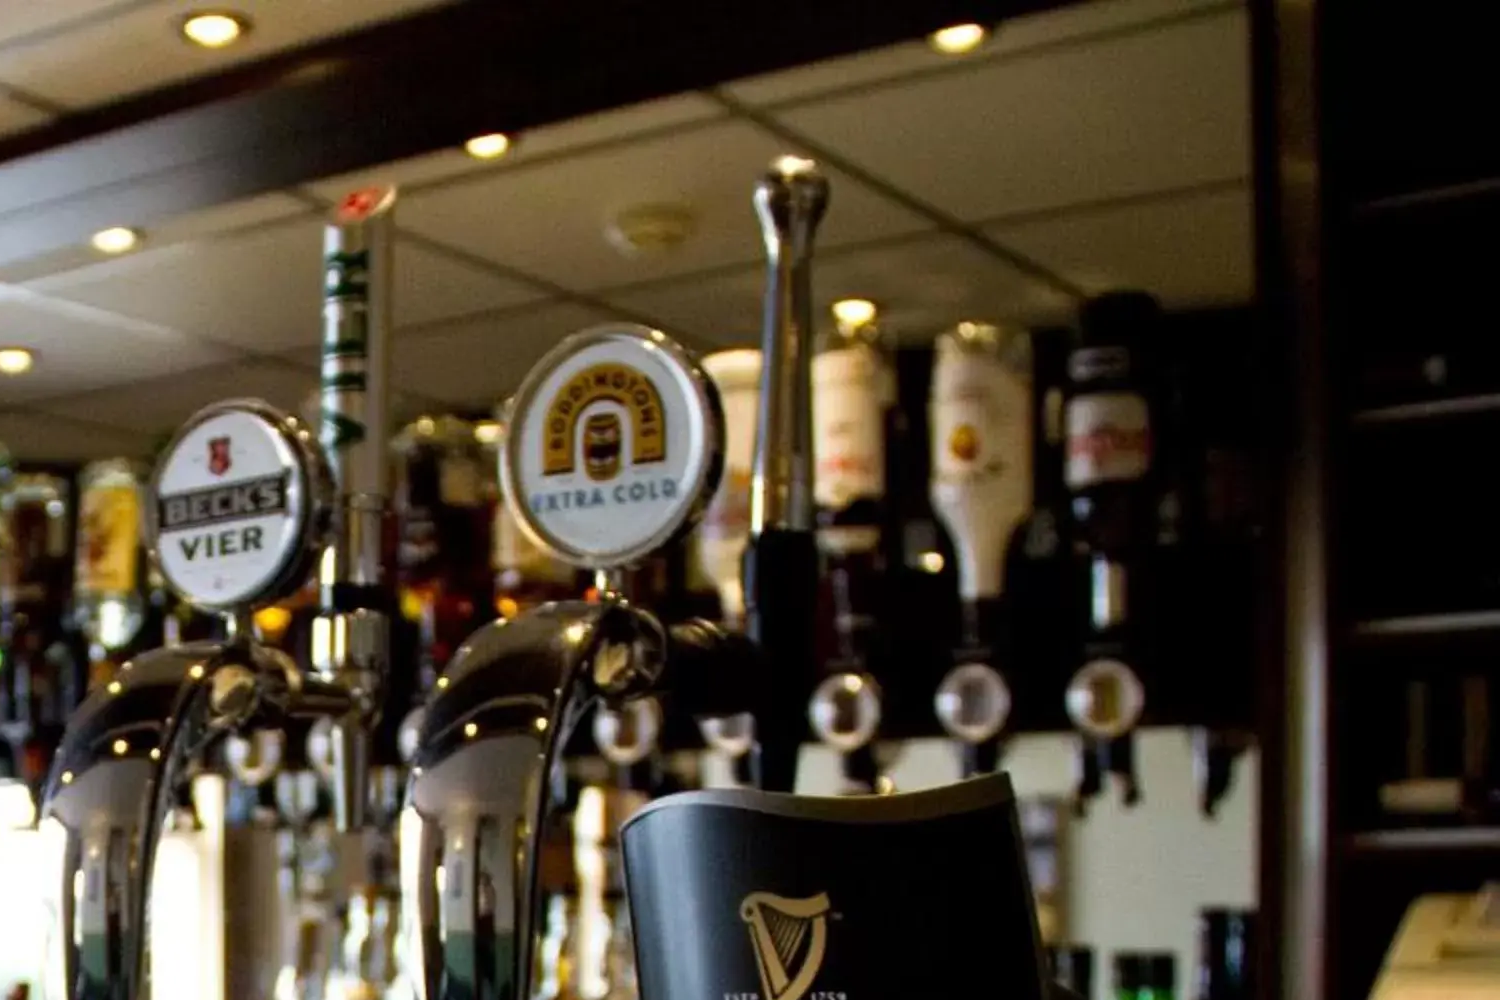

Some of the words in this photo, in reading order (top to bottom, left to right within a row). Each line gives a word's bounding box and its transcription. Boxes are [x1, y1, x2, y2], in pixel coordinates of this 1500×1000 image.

[531, 487, 605, 513] EXTRA
[612, 478, 676, 505] COLD
[179, 524, 264, 562] VIER
